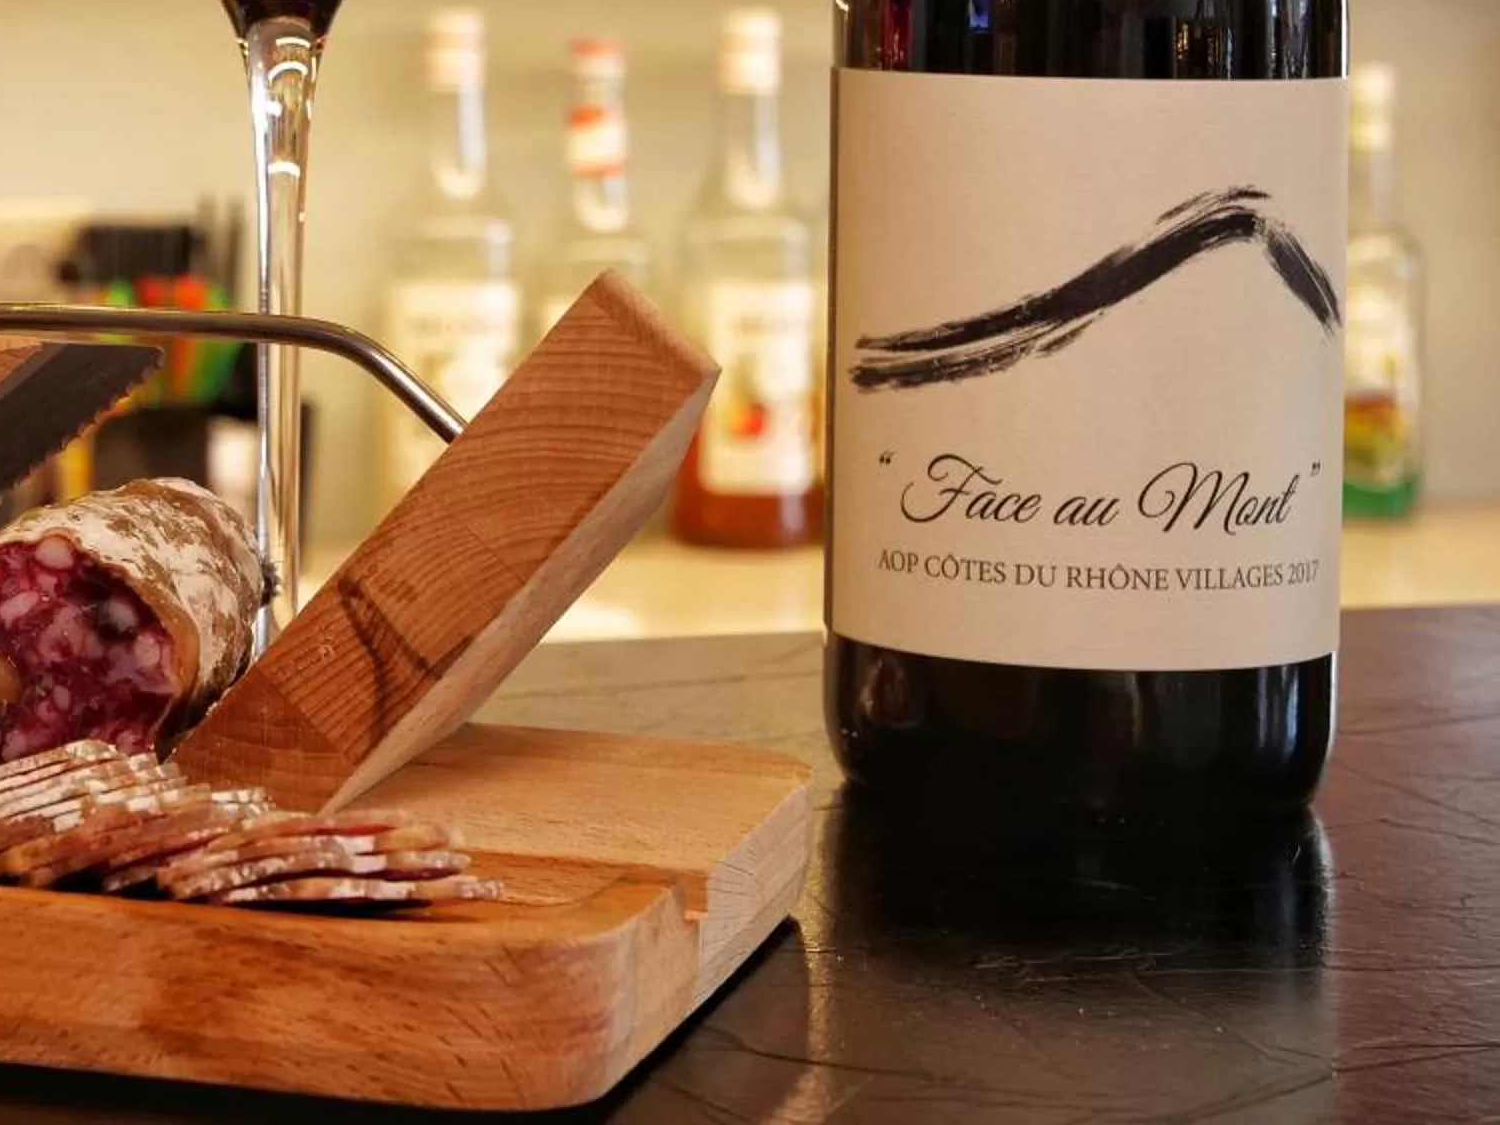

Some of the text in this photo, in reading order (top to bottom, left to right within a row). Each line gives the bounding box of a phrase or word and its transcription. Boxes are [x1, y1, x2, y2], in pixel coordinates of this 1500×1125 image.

[1053, 496, 1120, 526] au
[878, 548, 1320, 591] AOP CÔTES DU RHÔNE VILLAGES 2017
